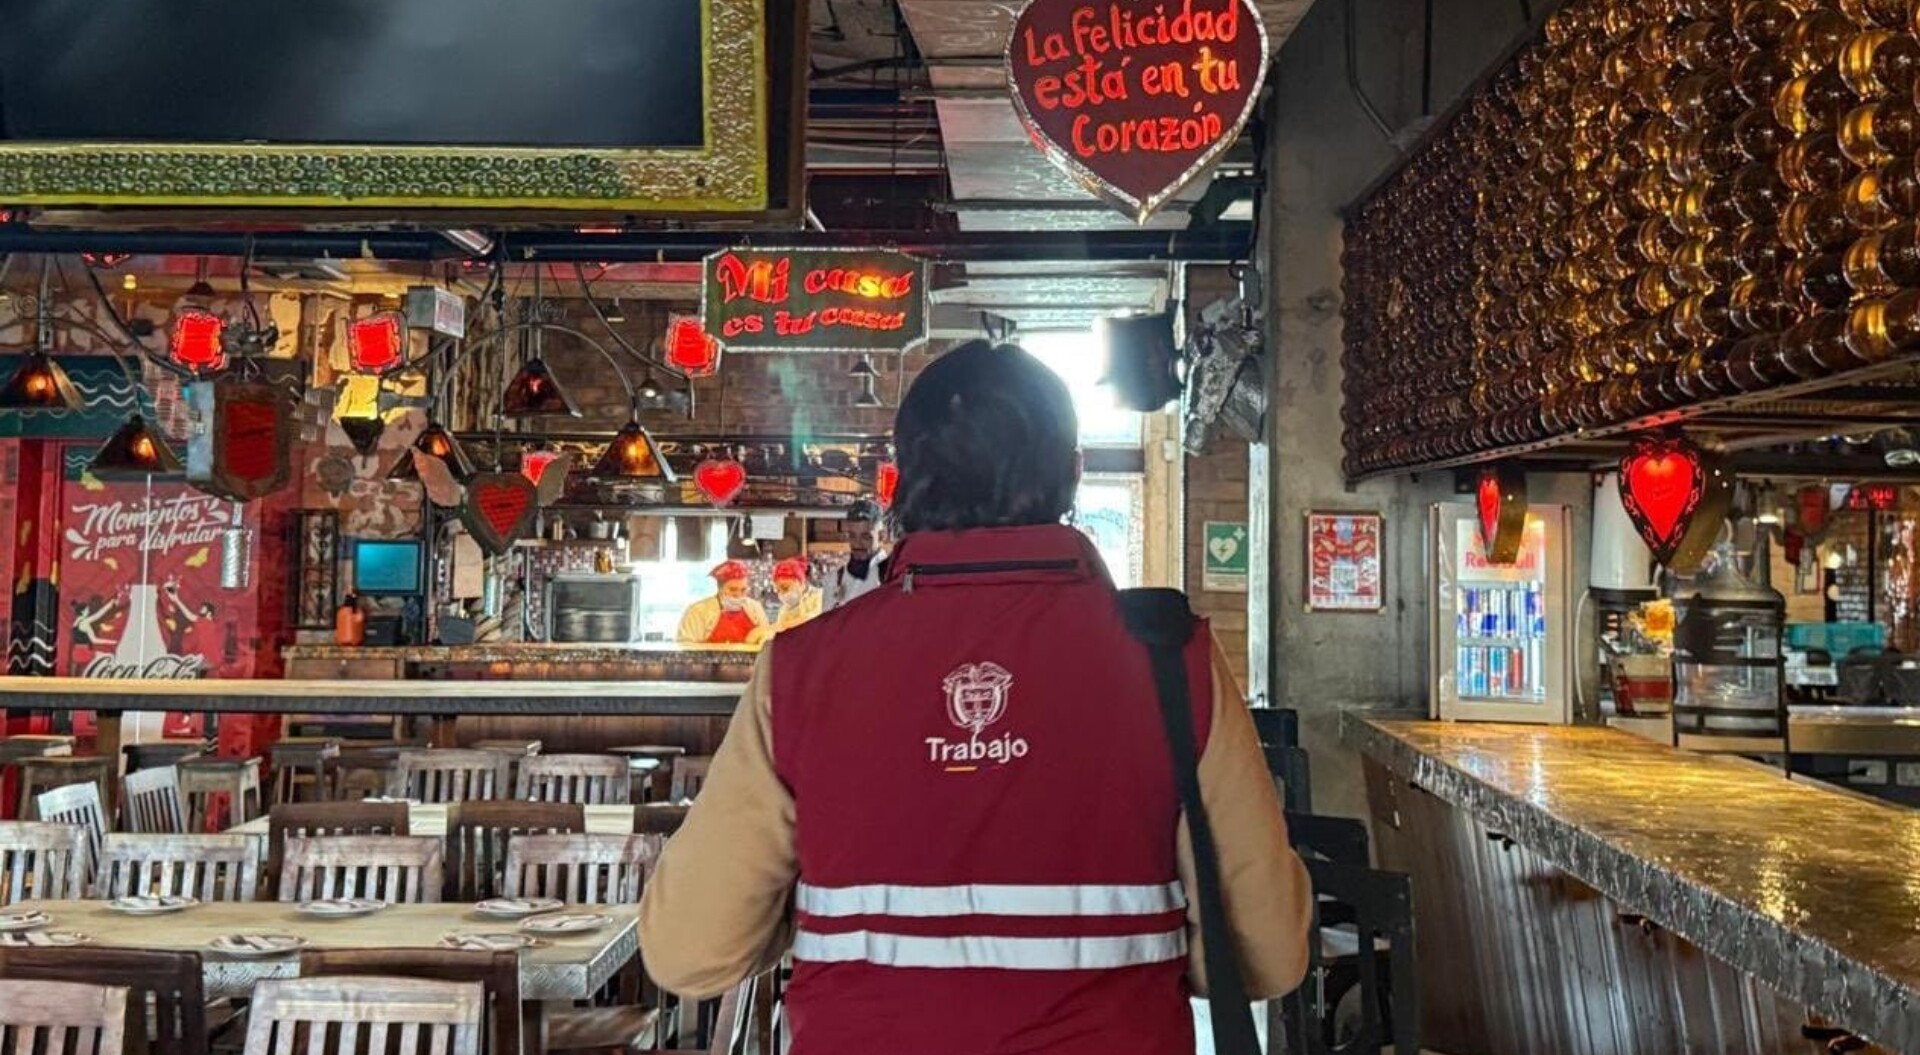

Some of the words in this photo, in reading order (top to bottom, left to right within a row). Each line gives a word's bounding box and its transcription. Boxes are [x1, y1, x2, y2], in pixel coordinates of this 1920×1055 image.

[1024, 26, 1070, 66] La
[1034, 55, 1131, 109] está
[1142, 62, 1189, 98] en
[1192, 47, 1240, 93] tu
[716, 253, 790, 304] Mi
[804, 266, 915, 299] casa
[723, 314, 764, 337] es
[774, 310, 817, 335] tu
[819, 307, 906, 330] casa
[71, 491, 214, 536] Momentos
[95, 532, 138, 561] para
[138, 517, 227, 556] disfrutar
[925, 732, 1029, 764] Trabajo
